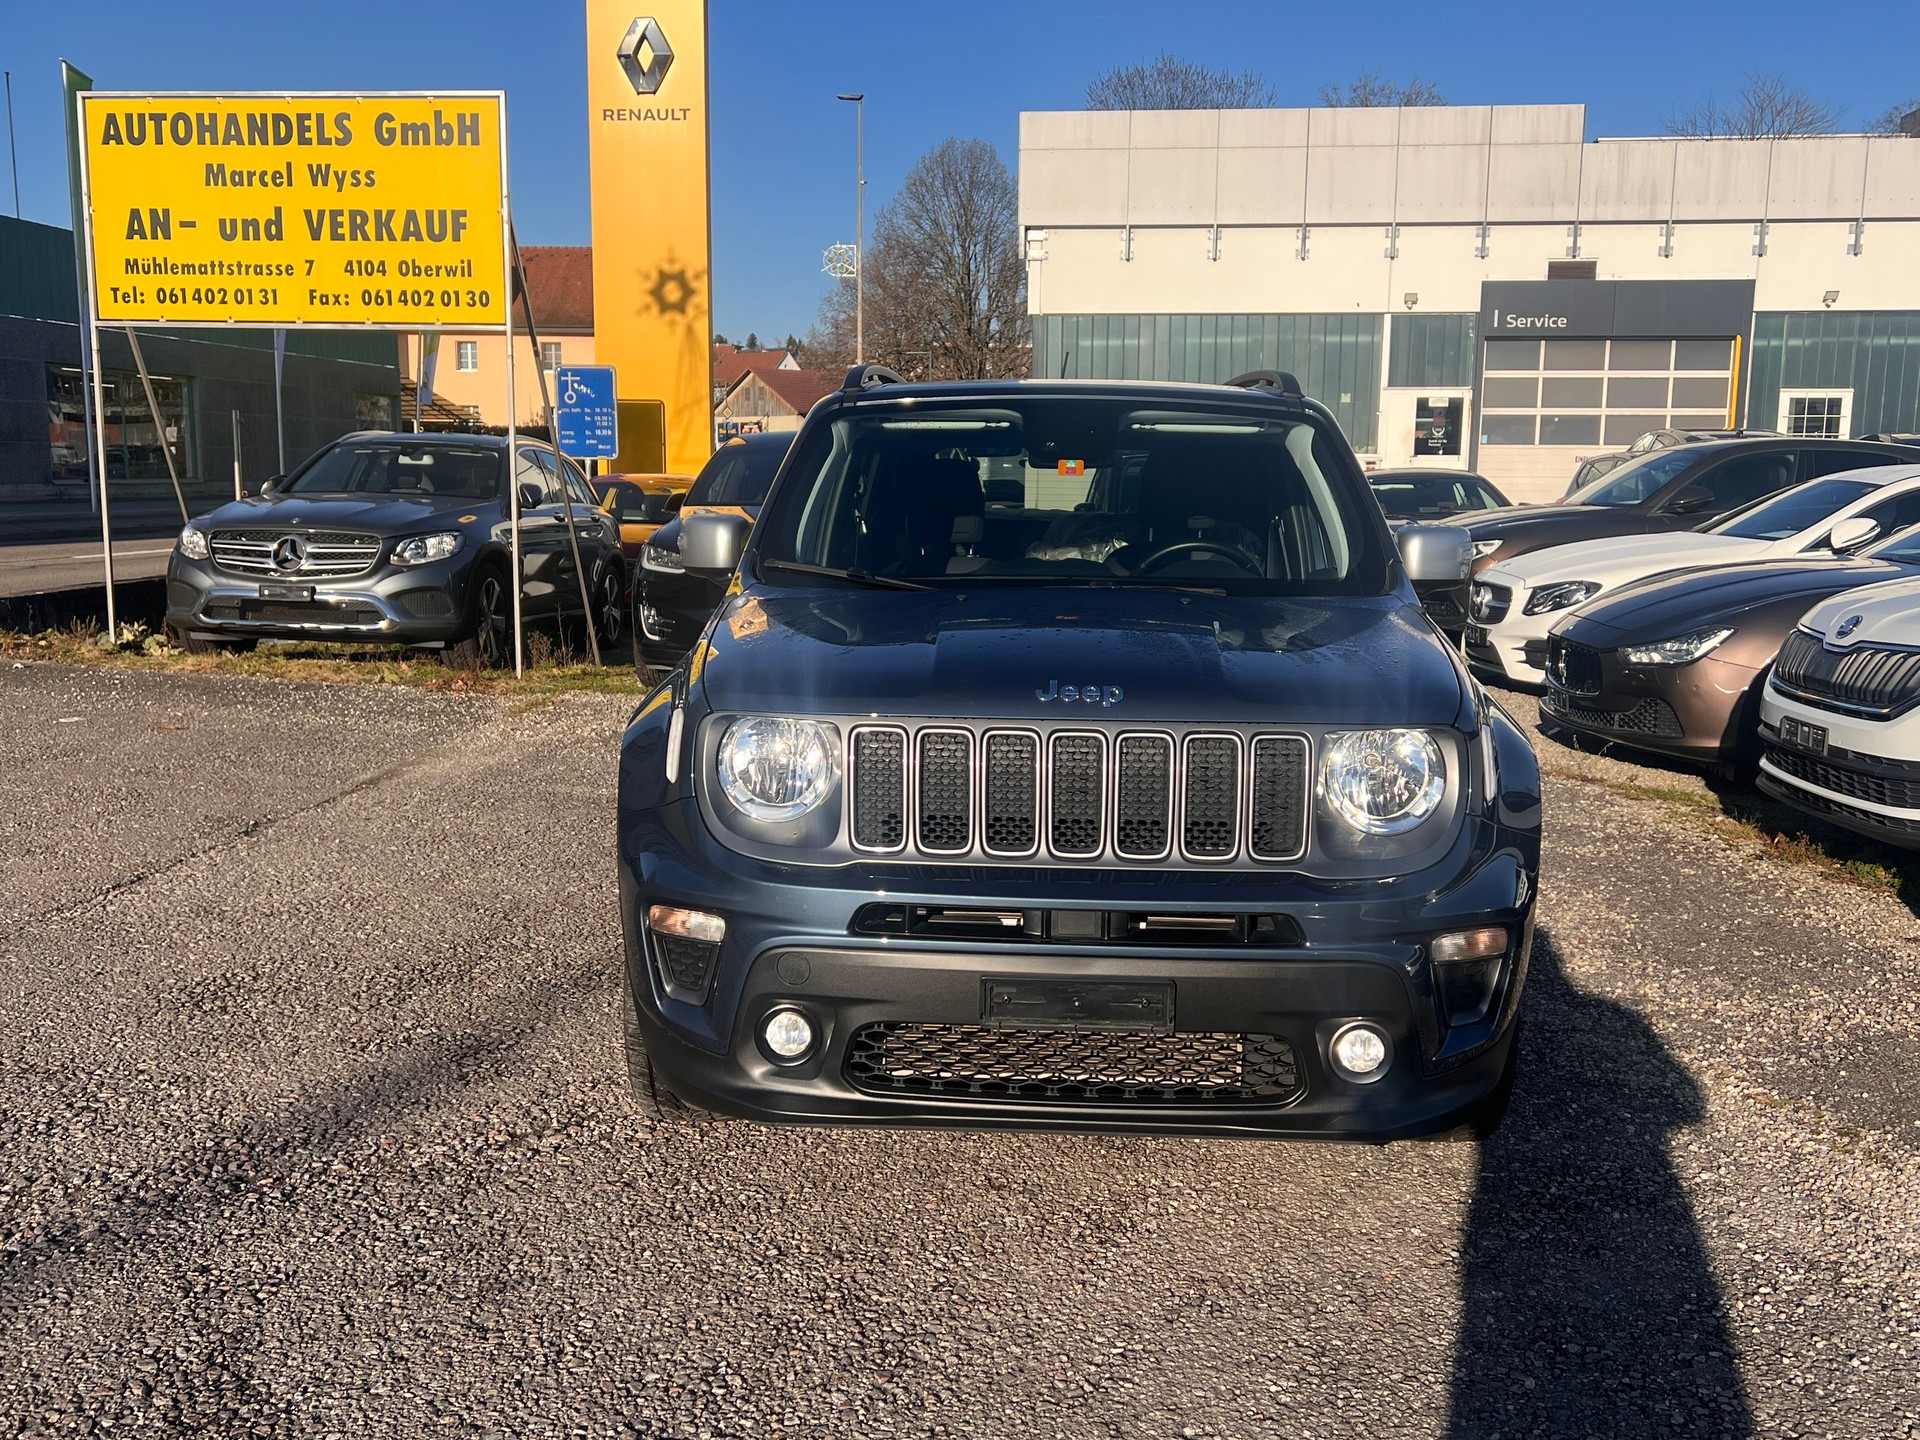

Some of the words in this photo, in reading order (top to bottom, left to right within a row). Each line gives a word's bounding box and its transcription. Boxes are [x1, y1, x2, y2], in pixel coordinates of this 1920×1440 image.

[602, 108, 690, 121] RENAULT
[102, 112, 352, 146] AUTOHANDELS
[375, 111, 479, 146] GmbH
[205, 162, 293, 187] Marcel
[308, 164, 376, 192] Wyss
[219, 207, 283, 241] und
[303, 209, 467, 242] VERKAUF
[125, 257, 294, 277] Mühlemattstrasse
[304, 260, 314, 276] 7
[344, 260, 387, 276] 4104
[398, 259, 472, 277] Oberwil
[110, 286, 145, 304] Tel:
[309, 289, 350, 306] Fax:
[1506, 313, 1568, 328] Service
[1035, 679, 1124, 708] Jeep
